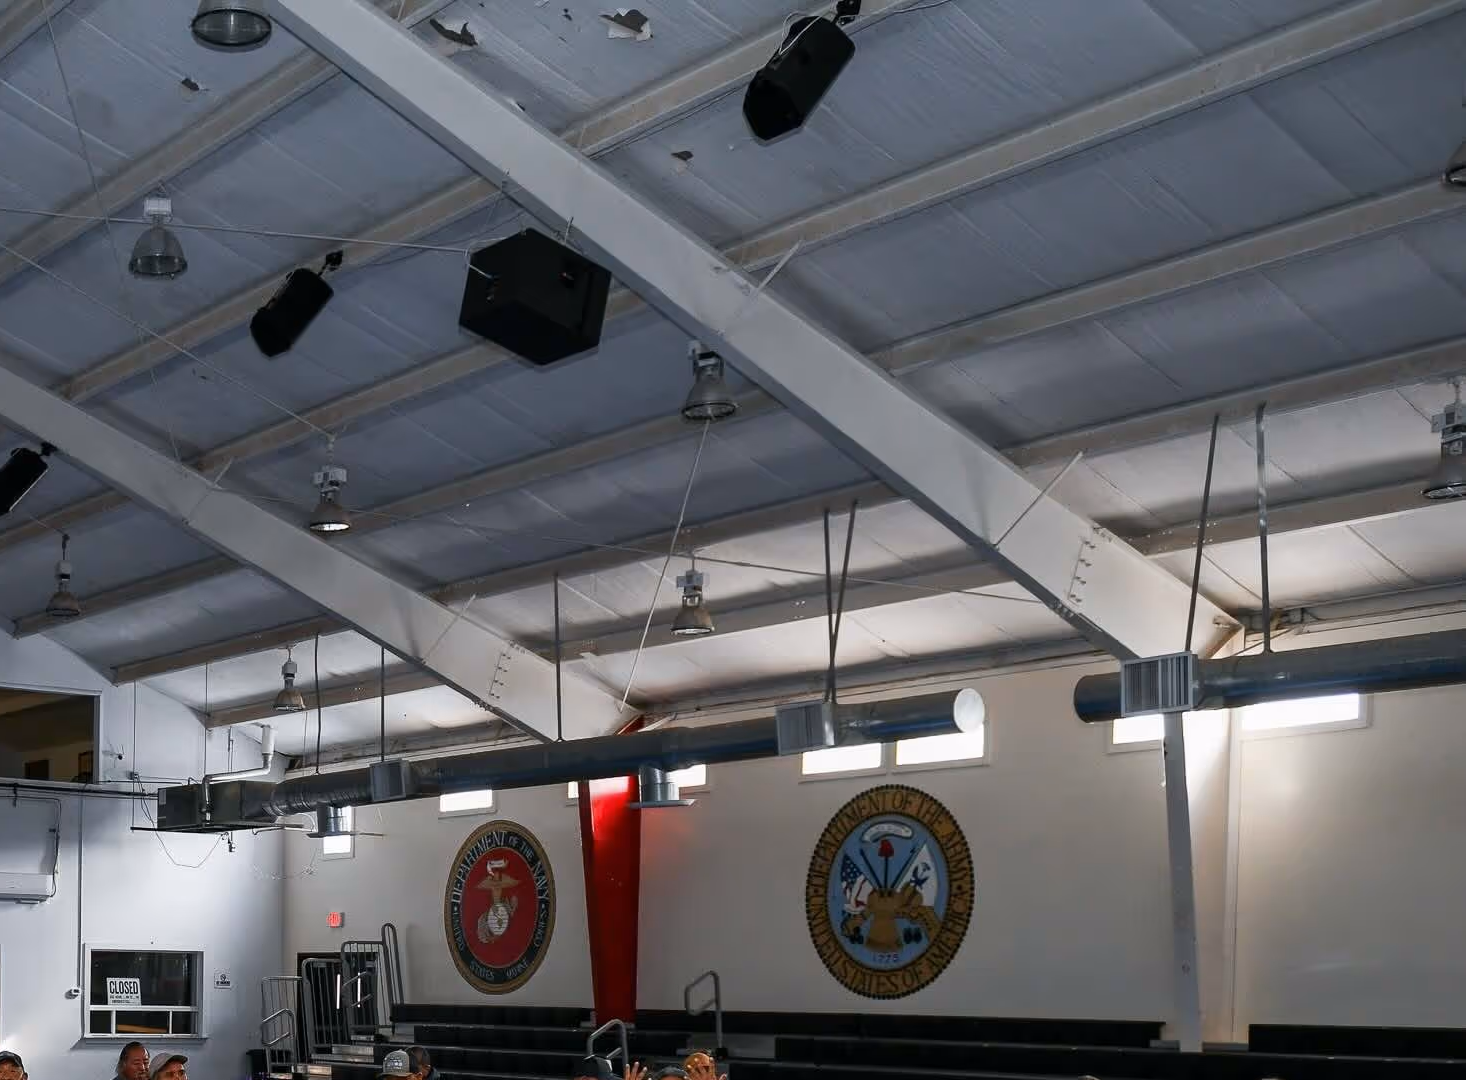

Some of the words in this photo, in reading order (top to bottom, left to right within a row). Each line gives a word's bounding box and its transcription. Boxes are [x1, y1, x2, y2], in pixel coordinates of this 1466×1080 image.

[451, 830, 508, 902] DEPARTMENT
[508, 835, 519, 847] OF
[532, 861, 550, 900] NAVY
[109, 981, 139, 994] CLOSED
